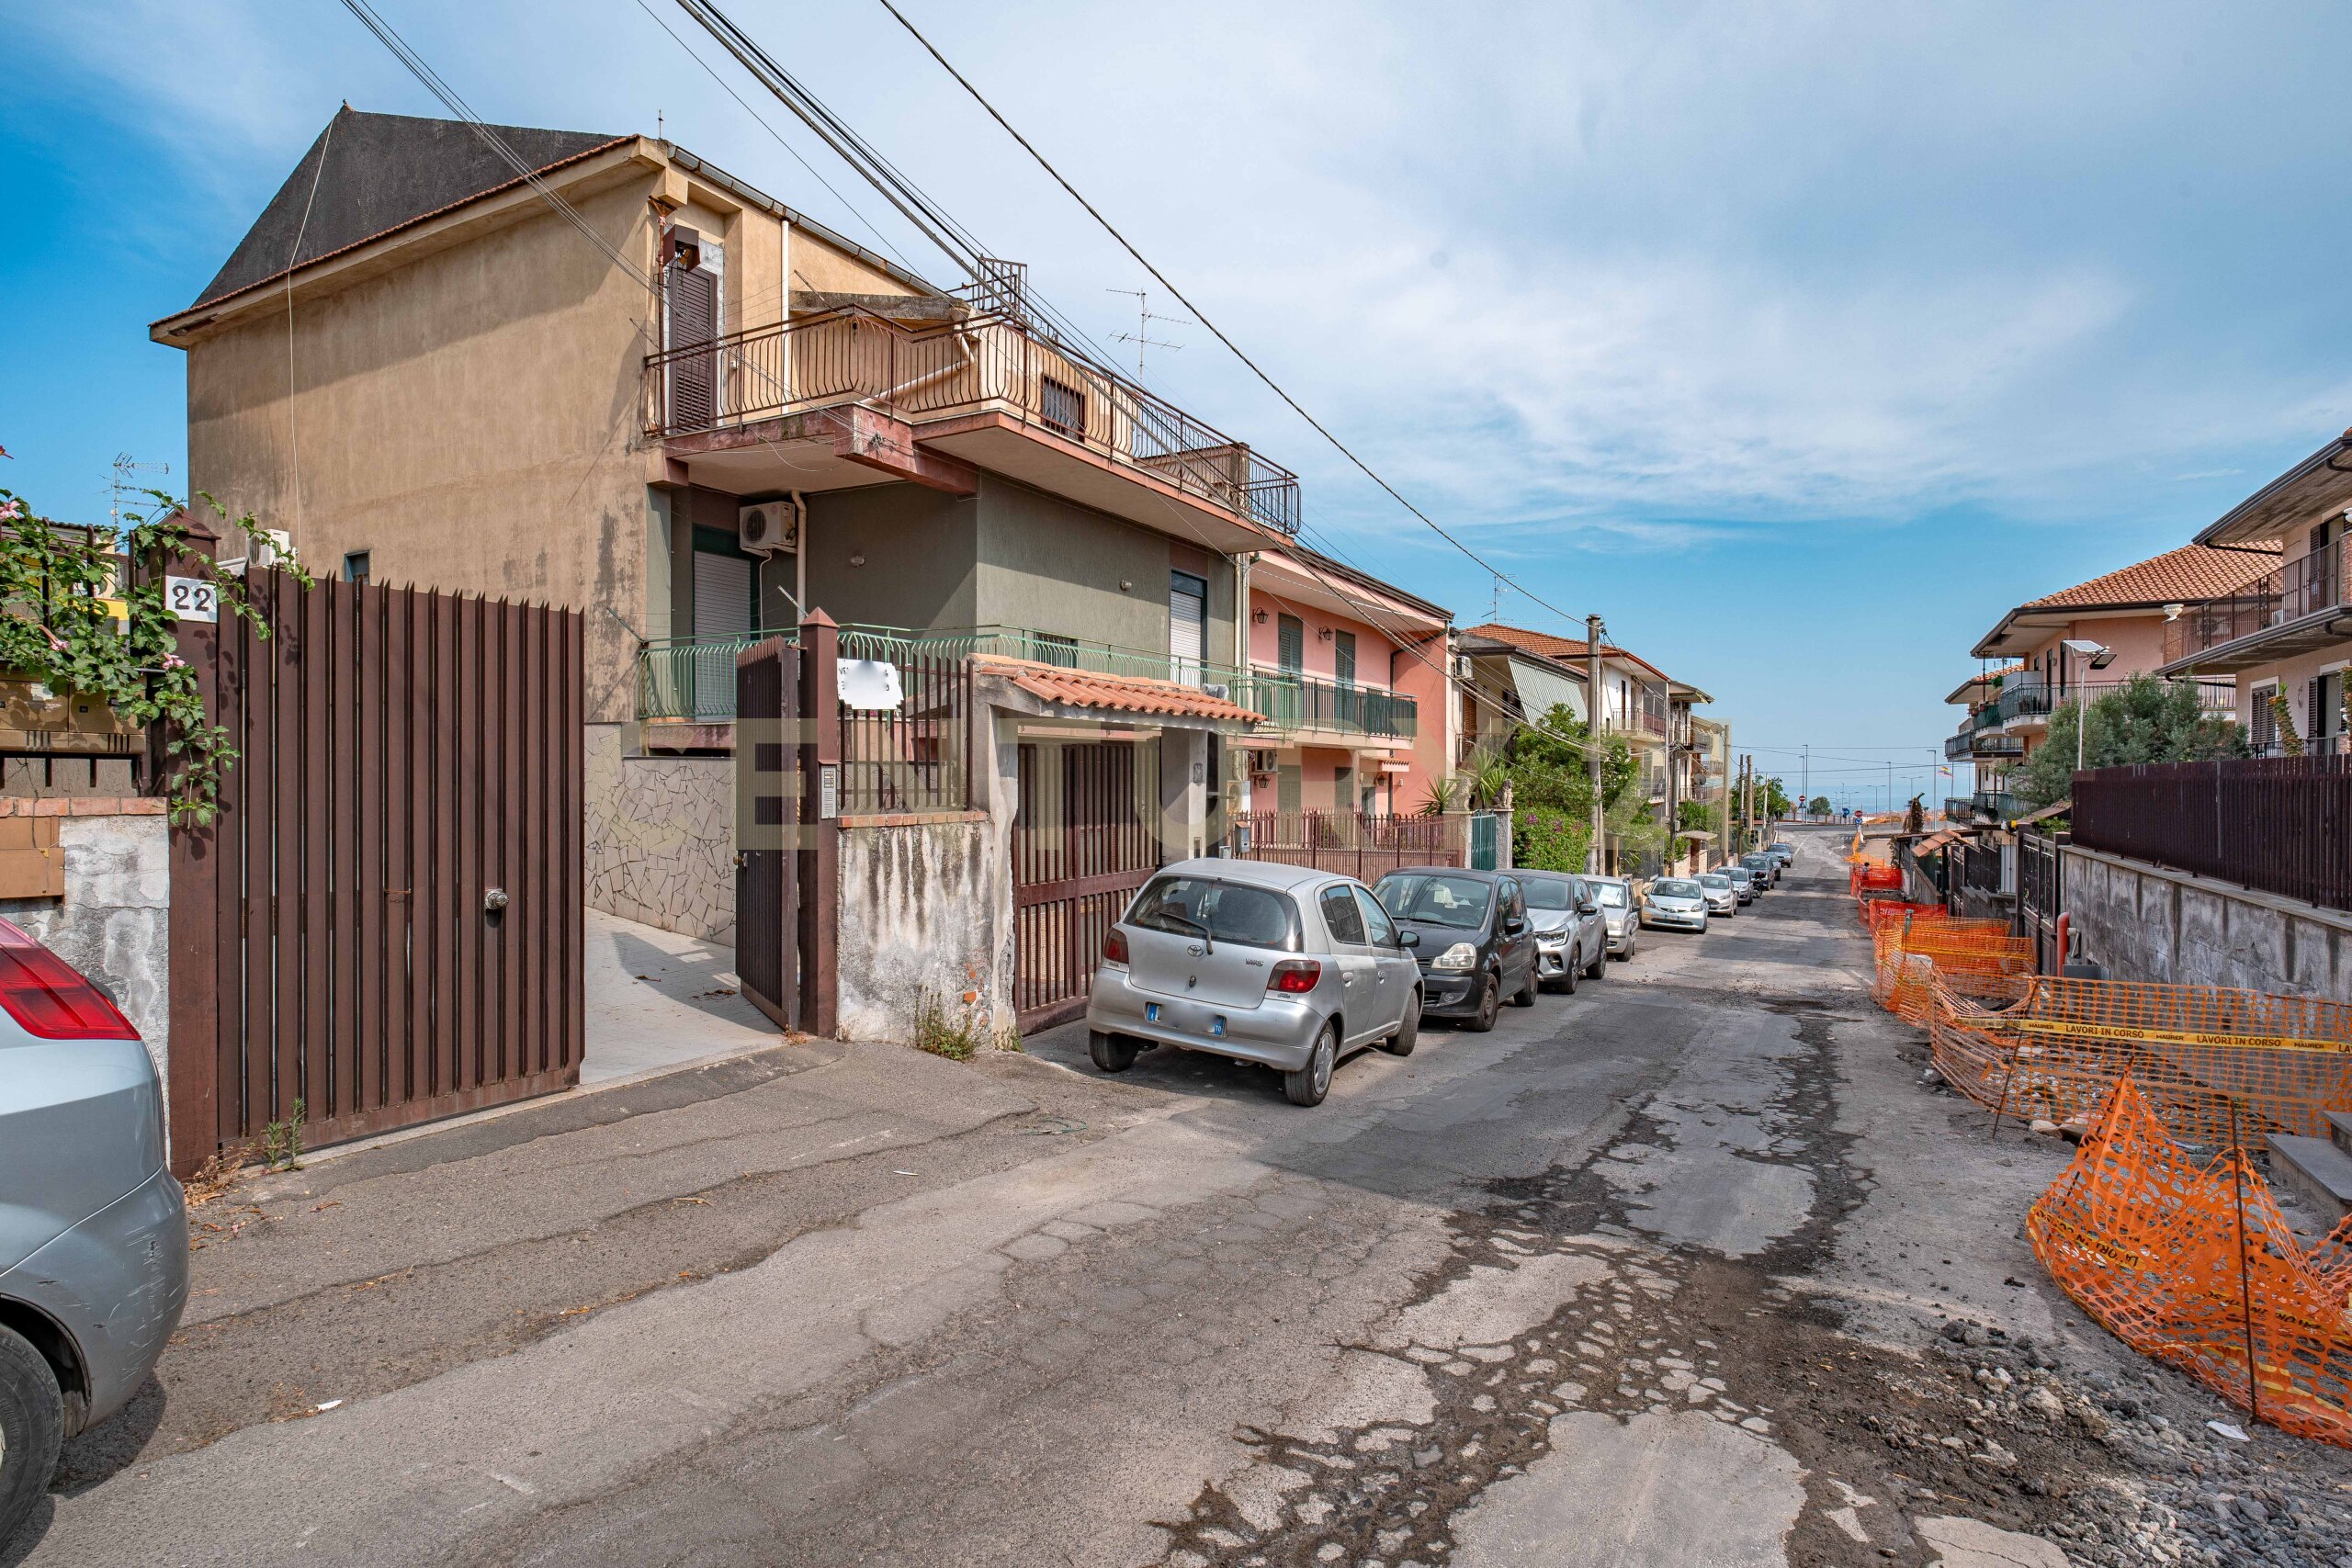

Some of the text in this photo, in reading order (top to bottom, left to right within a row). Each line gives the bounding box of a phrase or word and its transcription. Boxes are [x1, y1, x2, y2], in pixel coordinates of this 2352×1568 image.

[172, 584, 210, 613] 22
[2065, 1024, 2098, 1035] LAVORI
[2100, 1027, 2111, 1036] IN
[2113, 1029, 2144, 1039] CORSO
[2197, 1034, 2232, 1045] LAVORI
[2233, 1036, 2245, 1045] IN
[2248, 1038, 2281, 1048] CORSO
